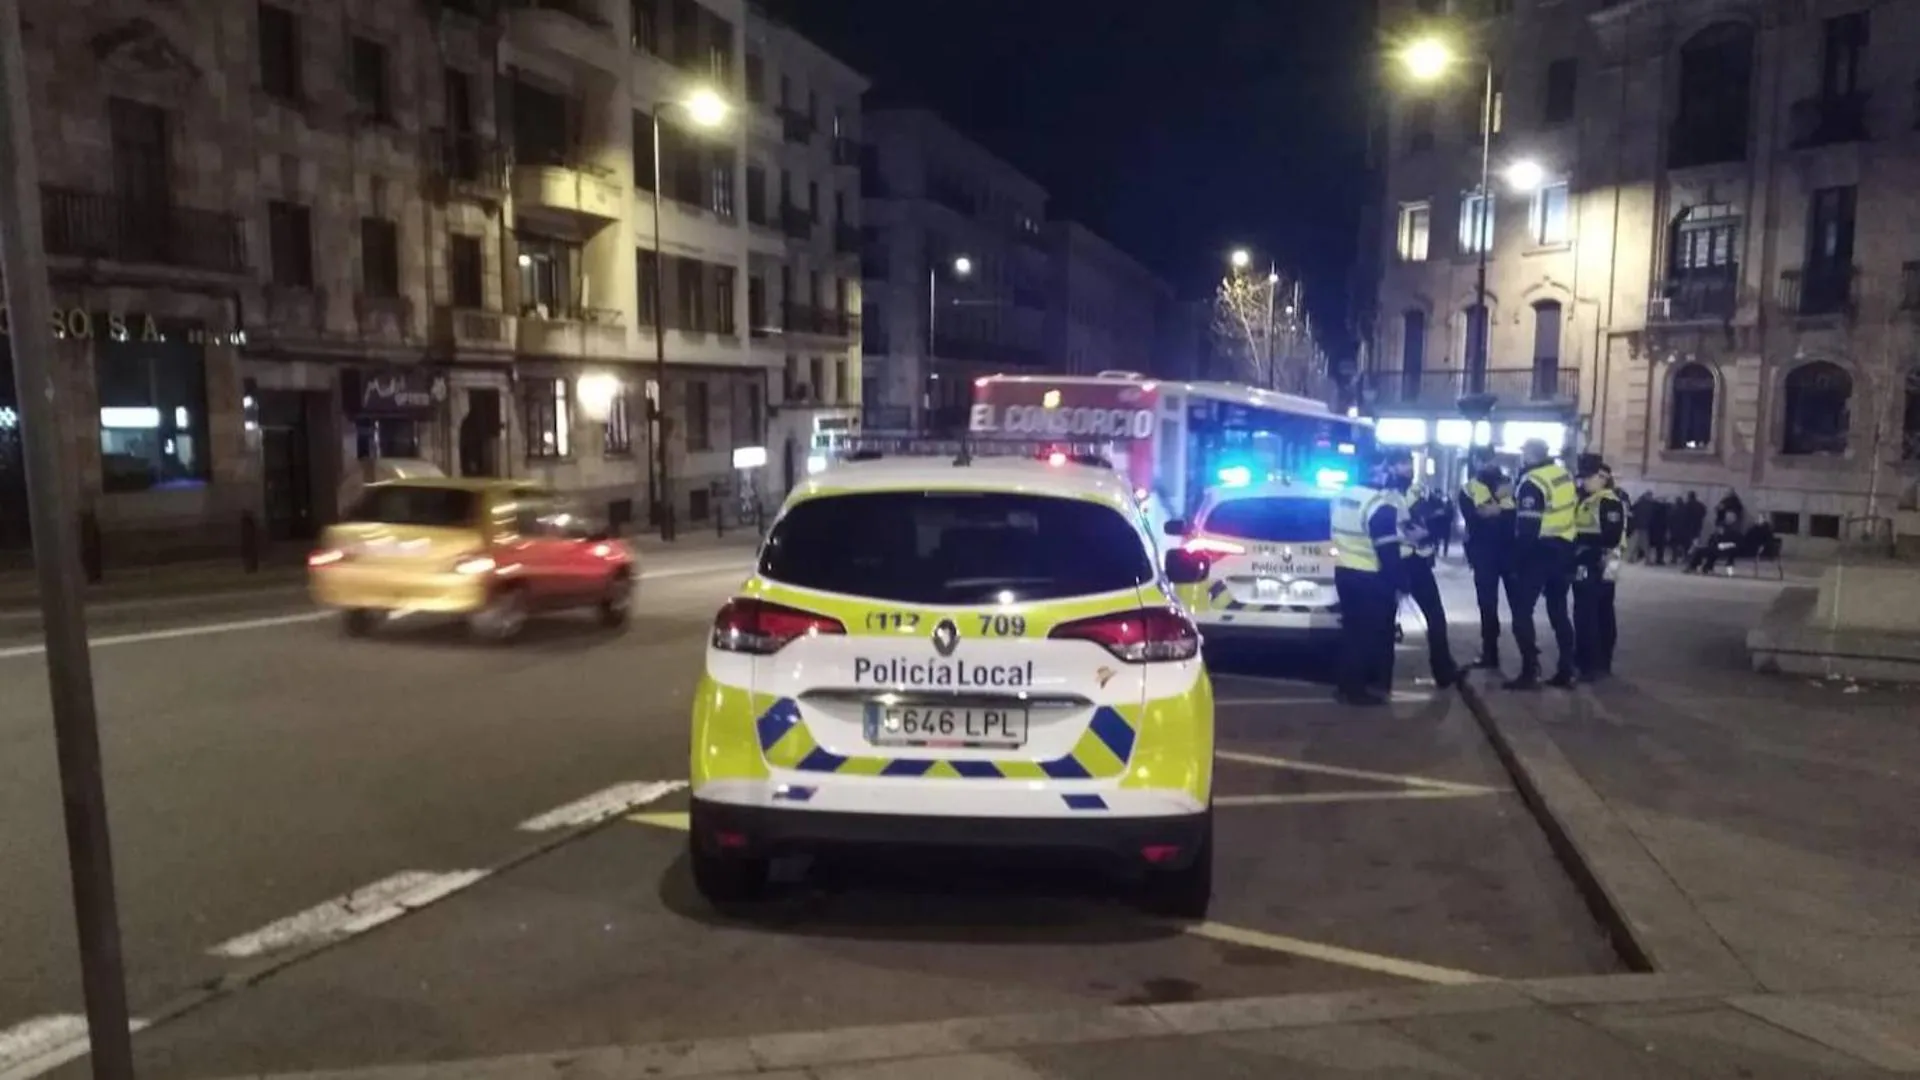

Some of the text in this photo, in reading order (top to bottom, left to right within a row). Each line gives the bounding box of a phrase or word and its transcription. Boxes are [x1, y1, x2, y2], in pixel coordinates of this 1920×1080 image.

[969, 404, 1154, 439] EL CONSORCIO
[979, 615, 1025, 636] 709
[885, 709, 1017, 738] 5646 LPL
